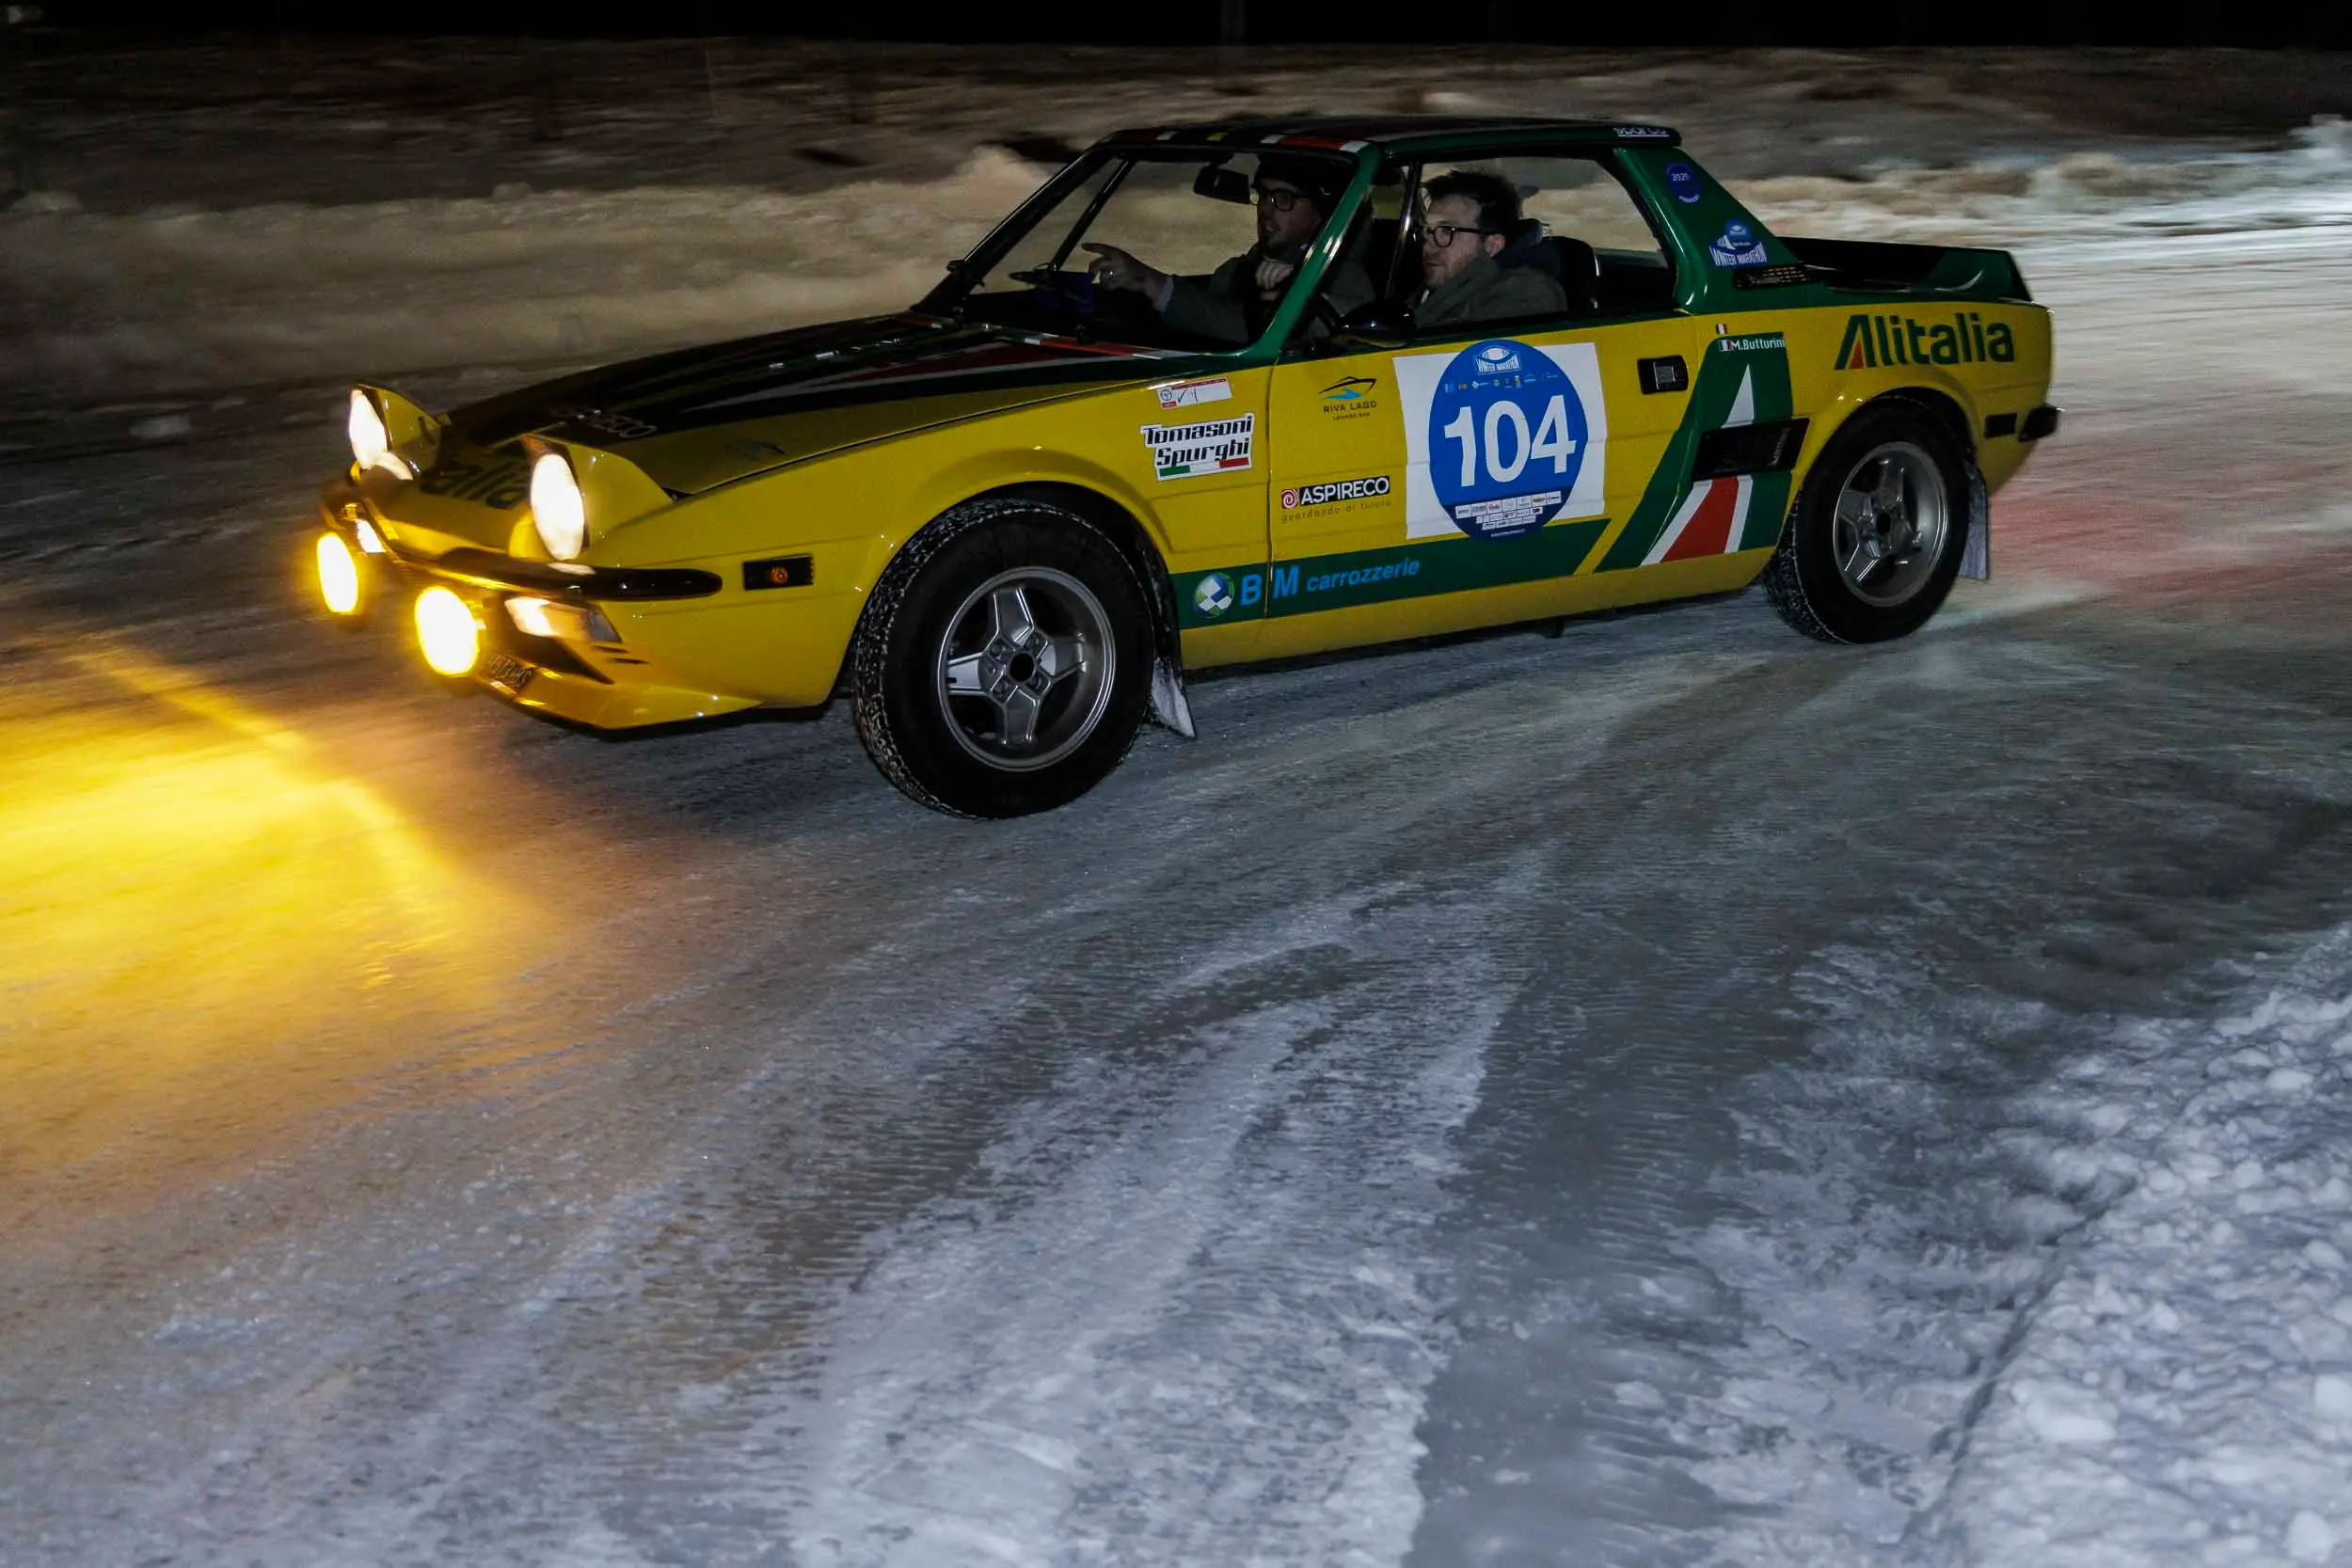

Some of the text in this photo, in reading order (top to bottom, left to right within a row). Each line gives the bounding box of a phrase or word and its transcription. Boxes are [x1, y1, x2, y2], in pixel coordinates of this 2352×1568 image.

[1835, 311, 2015, 370] Alitalia
[1324, 404, 1345, 413] RIVA
[1143, 415, 1252, 444] Tomasoni
[1444, 394, 1577, 487] 104
[1156, 437, 1249, 467] Spurghi
[1300, 477, 1390, 505] ASPIRECO
[1306, 558, 1421, 592] carrozzerie
